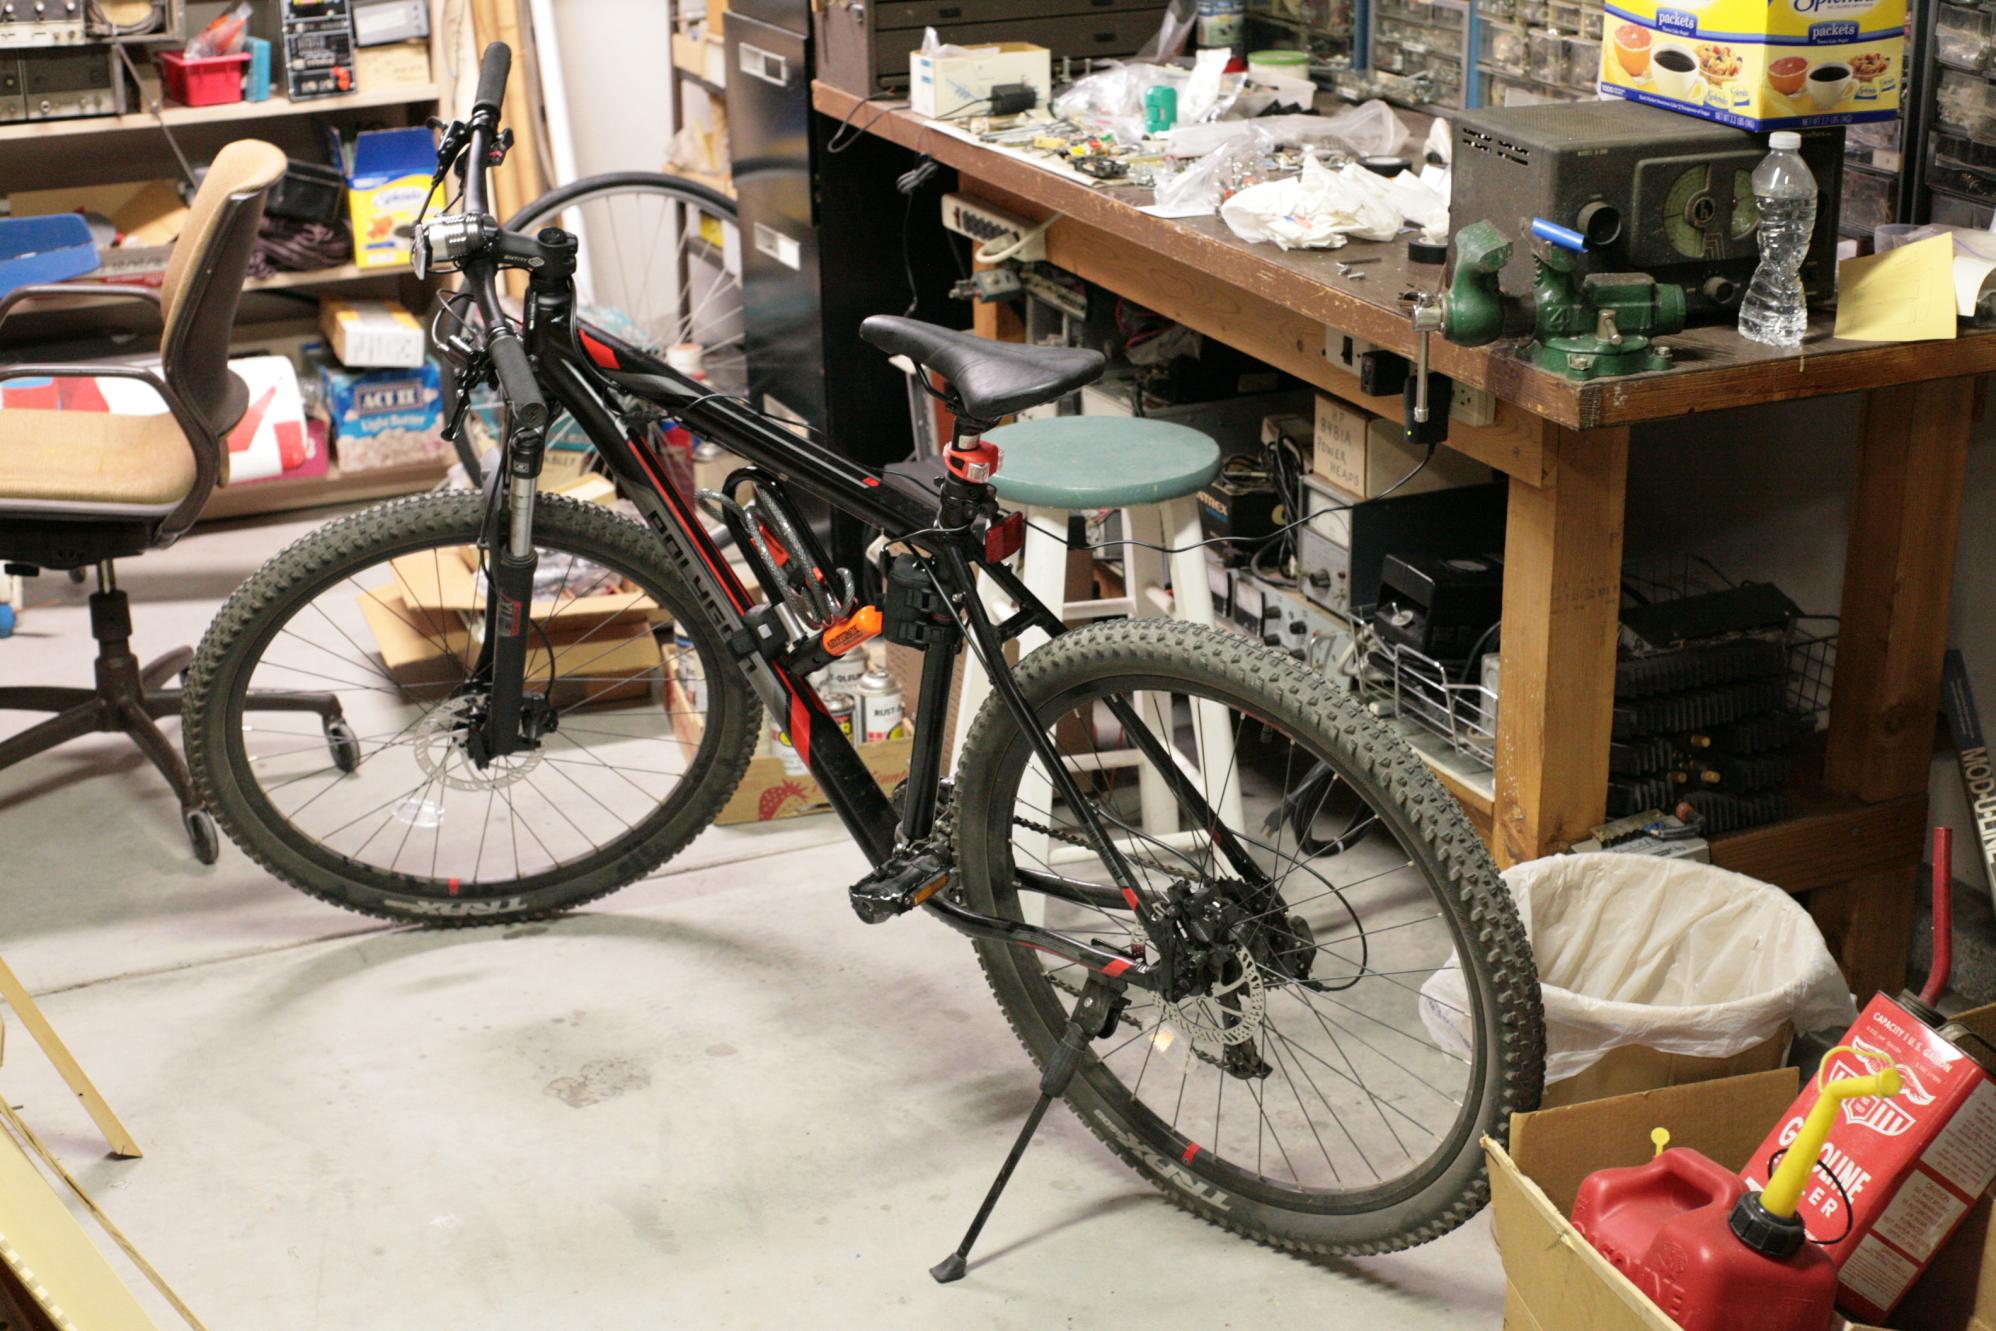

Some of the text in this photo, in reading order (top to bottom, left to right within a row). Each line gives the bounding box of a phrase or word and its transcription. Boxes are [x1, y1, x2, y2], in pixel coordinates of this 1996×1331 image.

[1658, 12, 1695, 29] packets
[1812, 23, 1856, 39] packets
[362, 391, 395, 409] ACT
[1873, 1012, 1905, 1038] CAPACITY
[1922, 1048, 1953, 1073] GALLON
[1116, 1131, 1232, 1212] TRAX
[1778, 1116, 1872, 1206] GOLINE
